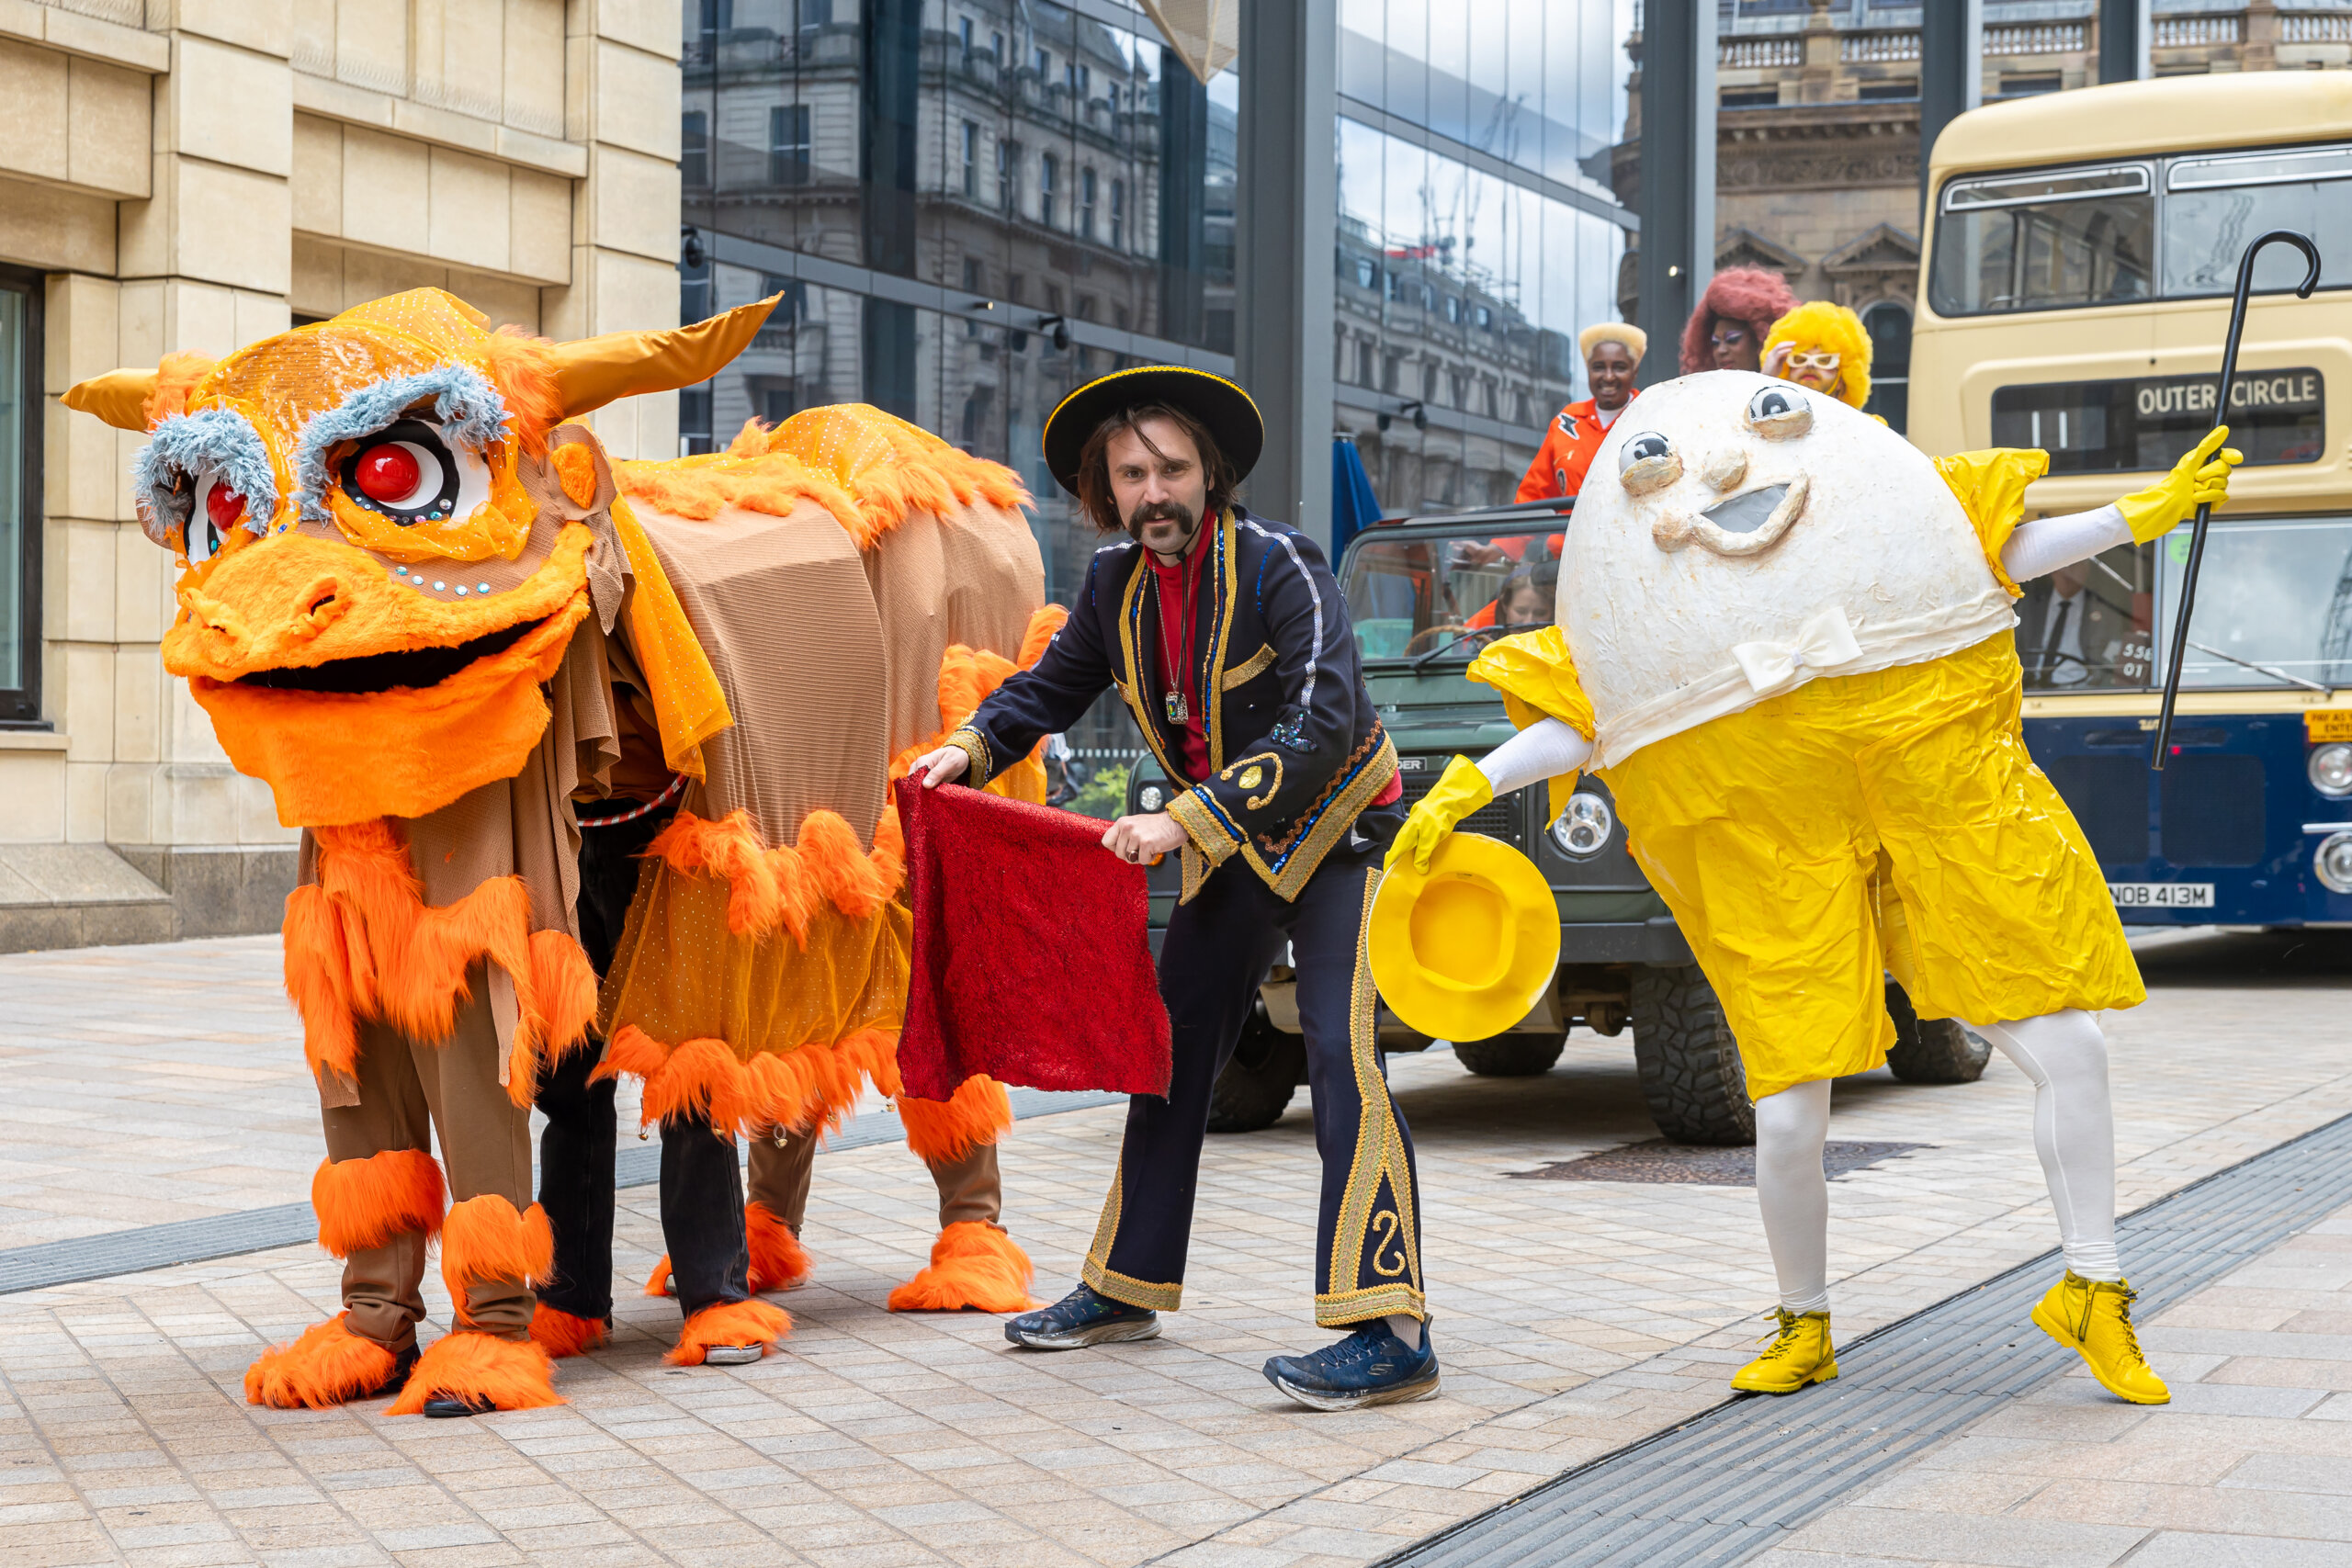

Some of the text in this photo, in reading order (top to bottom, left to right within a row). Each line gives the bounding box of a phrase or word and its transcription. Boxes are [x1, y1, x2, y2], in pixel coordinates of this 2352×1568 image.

[2137, 376, 2317, 415] OUTER CIRCLE
[2031, 411, 2068, 449] 11
[2108, 886, 2206, 904] NOB 413M
